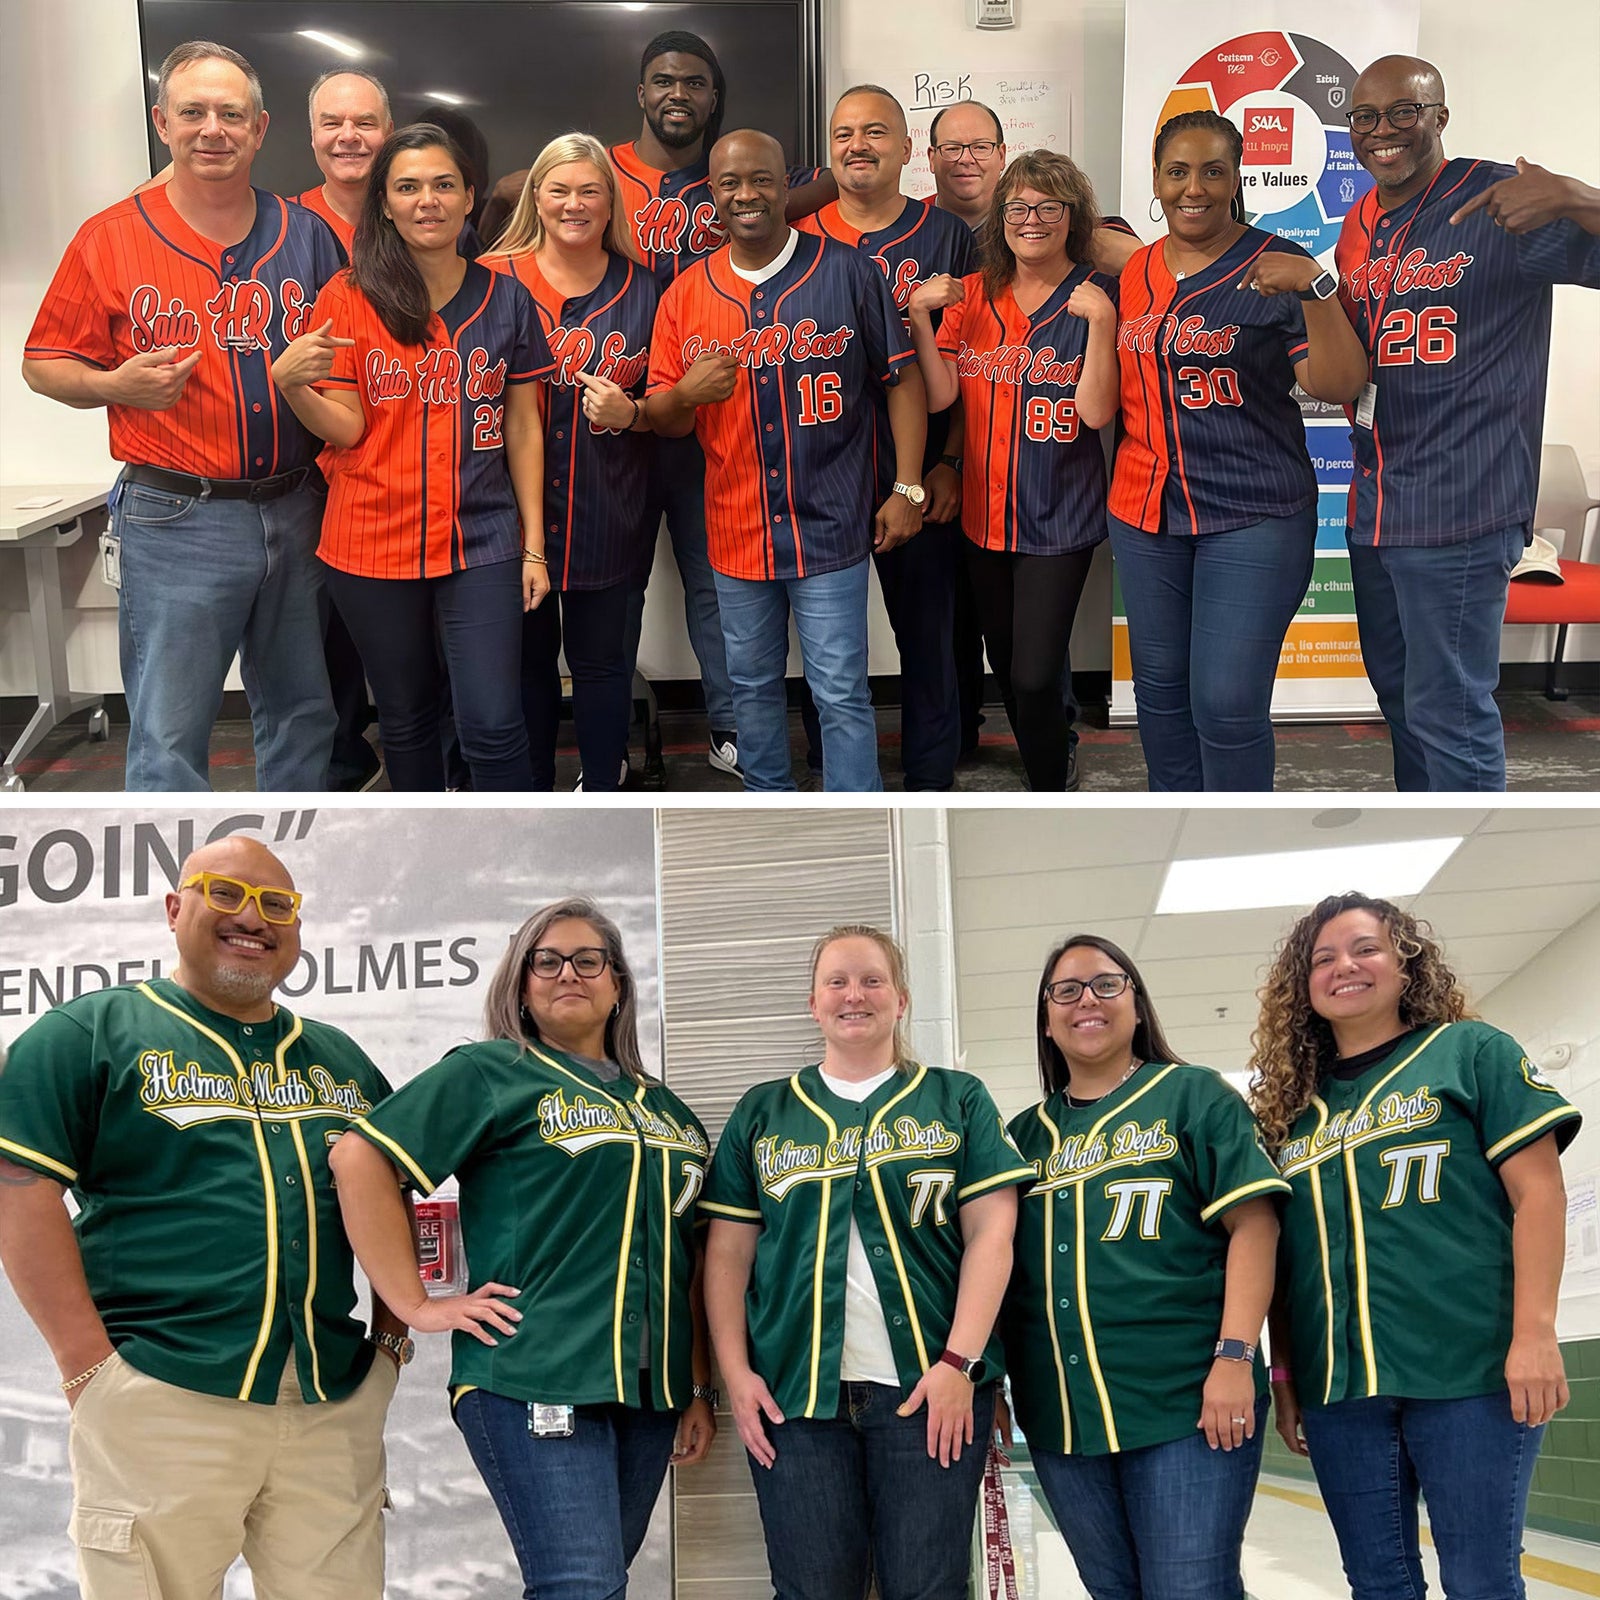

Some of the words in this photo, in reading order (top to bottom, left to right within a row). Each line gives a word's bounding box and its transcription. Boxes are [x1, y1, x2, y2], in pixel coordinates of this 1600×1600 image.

[1241, 175, 1257, 187] re
[1262, 171, 1308, 187] Values
[1394, 248, 1474, 295] East
[129, 284, 201, 354] Saia
[1174, 315, 1240, 358] East
[1378, 306, 1458, 367] 26
[366, 348, 412, 406] Saia
[797, 371, 843, 427] 16
[1178, 366, 1244, 410] 30
[1025, 396, 1081, 442] 89
[278, 937, 479, 998] OLMES
[140, 1050, 239, 1105] Holmes
[239, 1061, 315, 1108] Math
[538, 1088, 621, 1140] Holmes
[755, 1135, 820, 1186] Holmes
[1046, 1133, 1109, 1179] Math
[420, 1222, 440, 1236] RE
